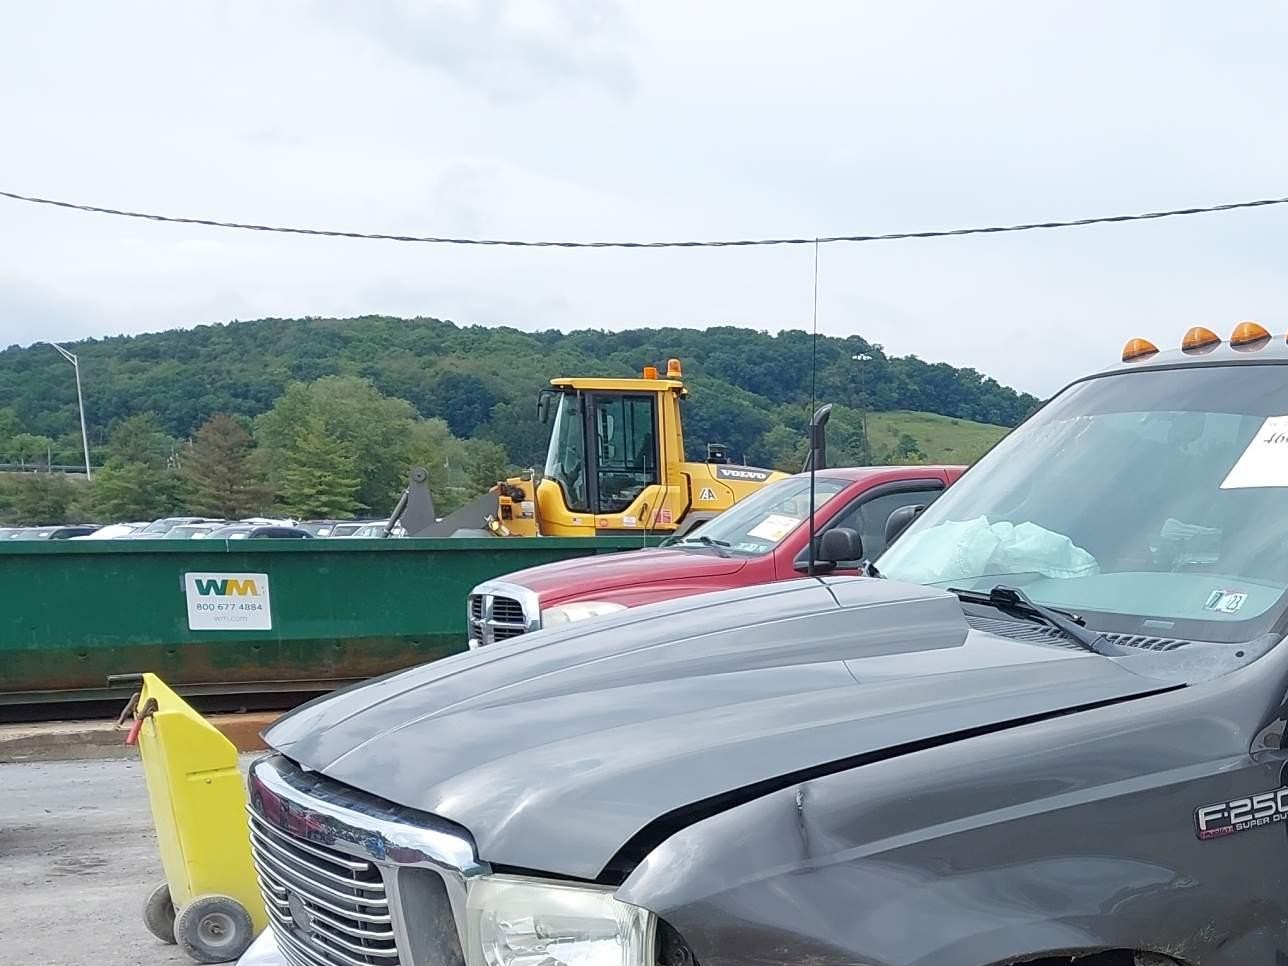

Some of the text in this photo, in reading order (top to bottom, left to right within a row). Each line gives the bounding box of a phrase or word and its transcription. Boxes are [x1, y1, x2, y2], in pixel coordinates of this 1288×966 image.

[720, 469, 766, 479] VOLVO
[195, 579, 258, 596] WM
[197, 603, 263, 611] 800 677 4884
[1235, 817, 1270, 831] SUPER
